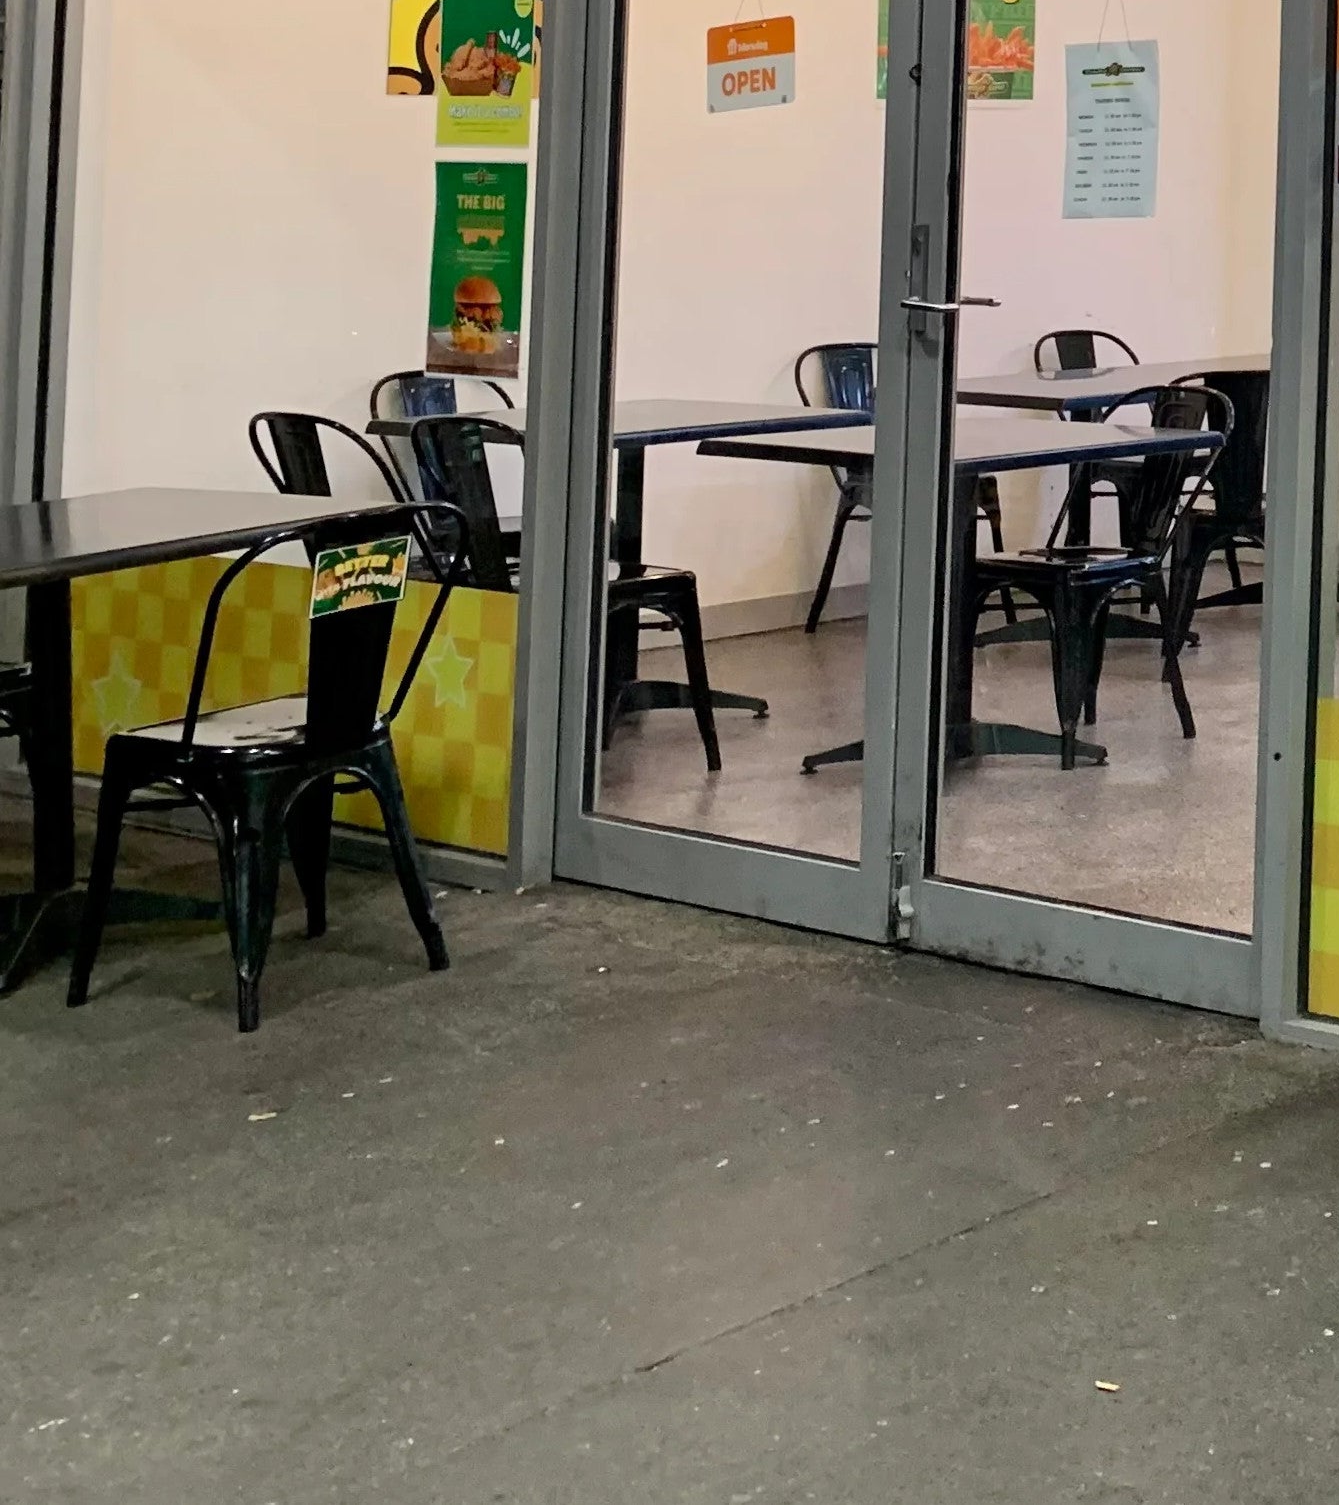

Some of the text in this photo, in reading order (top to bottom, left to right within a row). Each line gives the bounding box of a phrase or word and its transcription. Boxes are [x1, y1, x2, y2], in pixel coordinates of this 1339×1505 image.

[722, 66, 775, 96] OPEN
[456, 194, 505, 210] THE BIG
